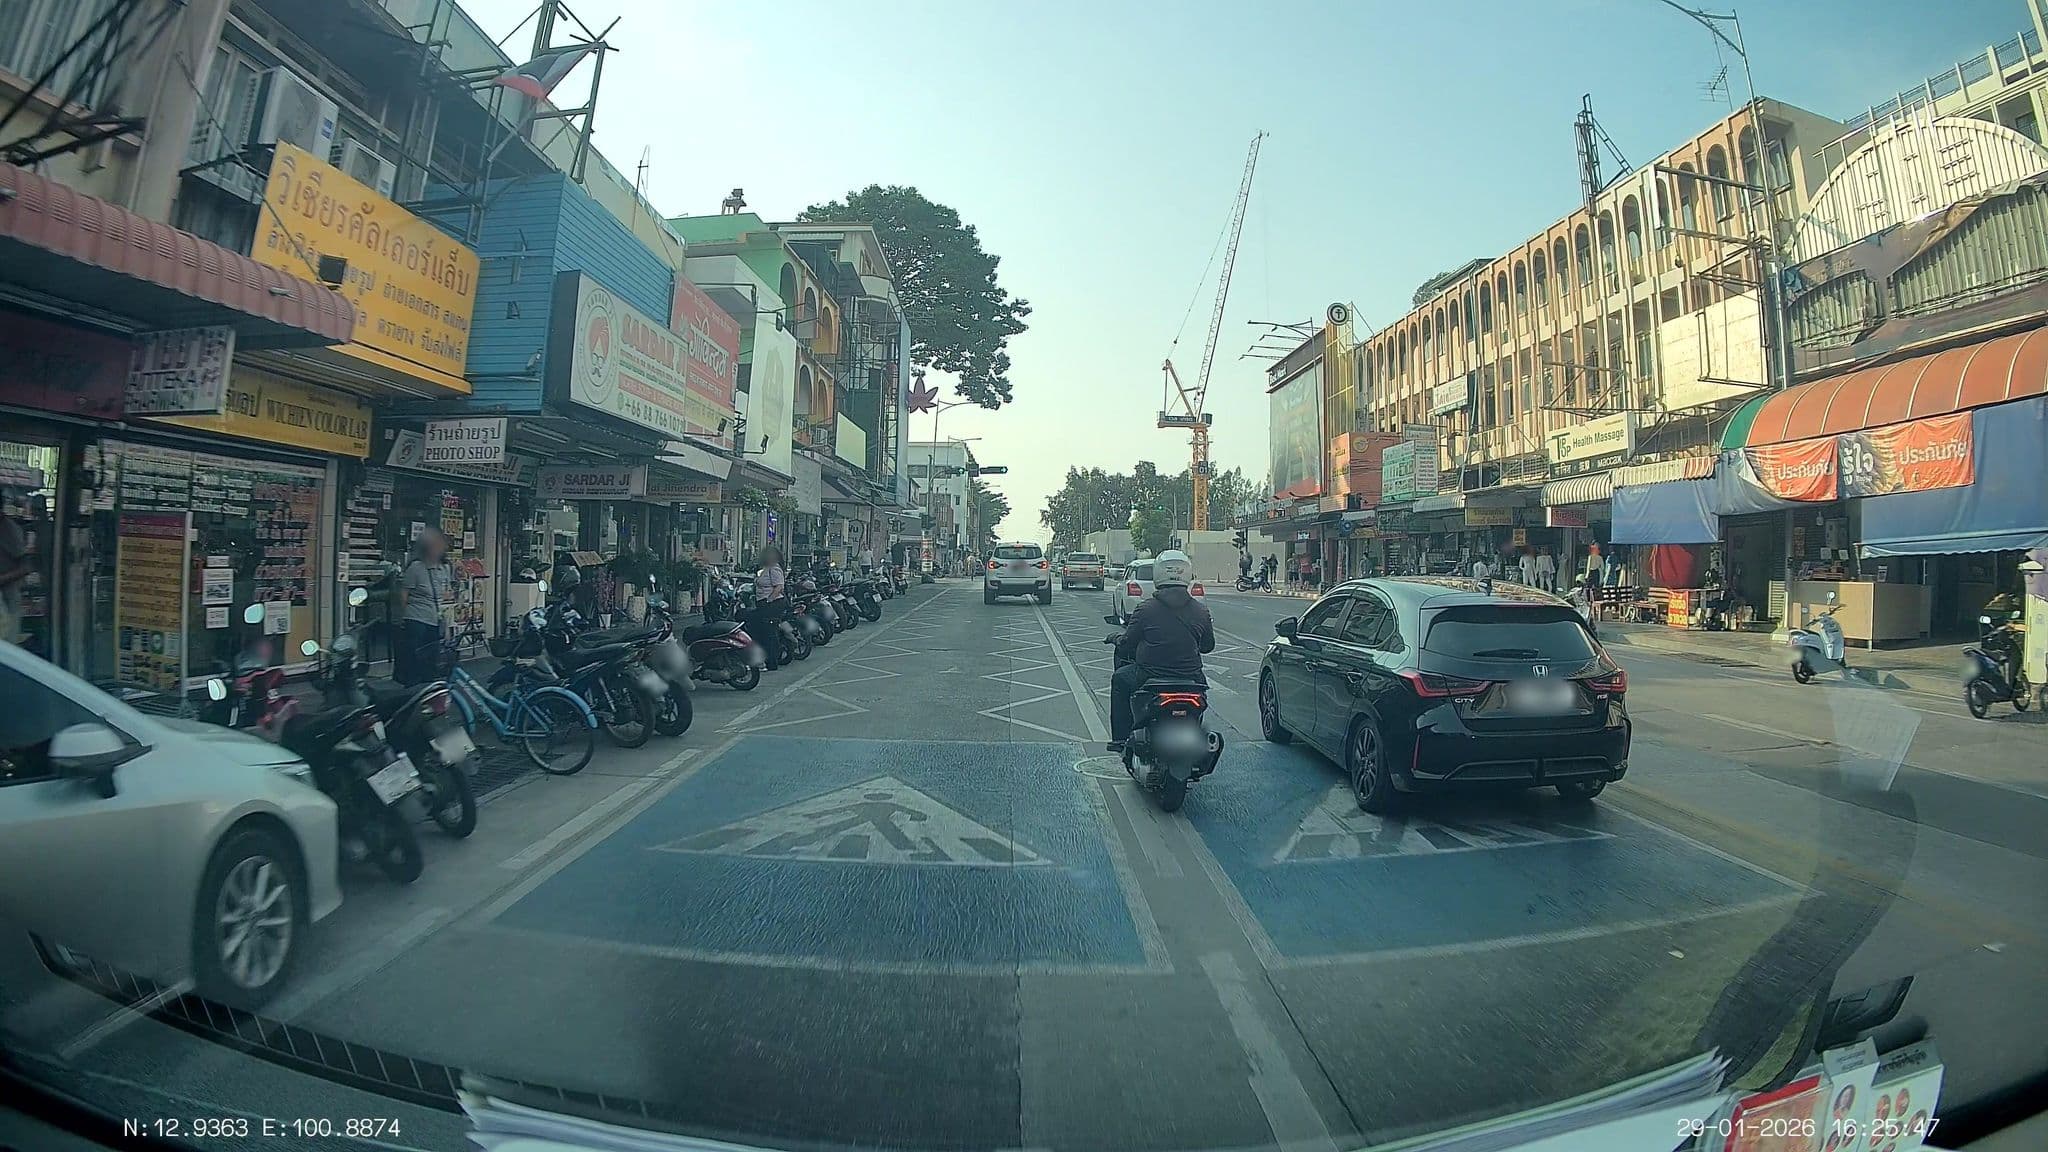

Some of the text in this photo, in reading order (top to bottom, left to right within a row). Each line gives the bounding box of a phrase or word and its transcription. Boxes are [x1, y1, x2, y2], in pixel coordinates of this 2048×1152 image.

[428, 419, 502, 444] ร้านถ่ายรูป
[1572, 435, 1593, 448] Health
[1595, 429, 1625, 443] Massage
[425, 445, 501, 461] PHOTO SHOP
[1842, 437, 1968, 486] รู้ใจ ประกันภัย
[563, 473, 630, 486] SARDAR JI
[1777, 457, 1835, 481] ประกันภัย
